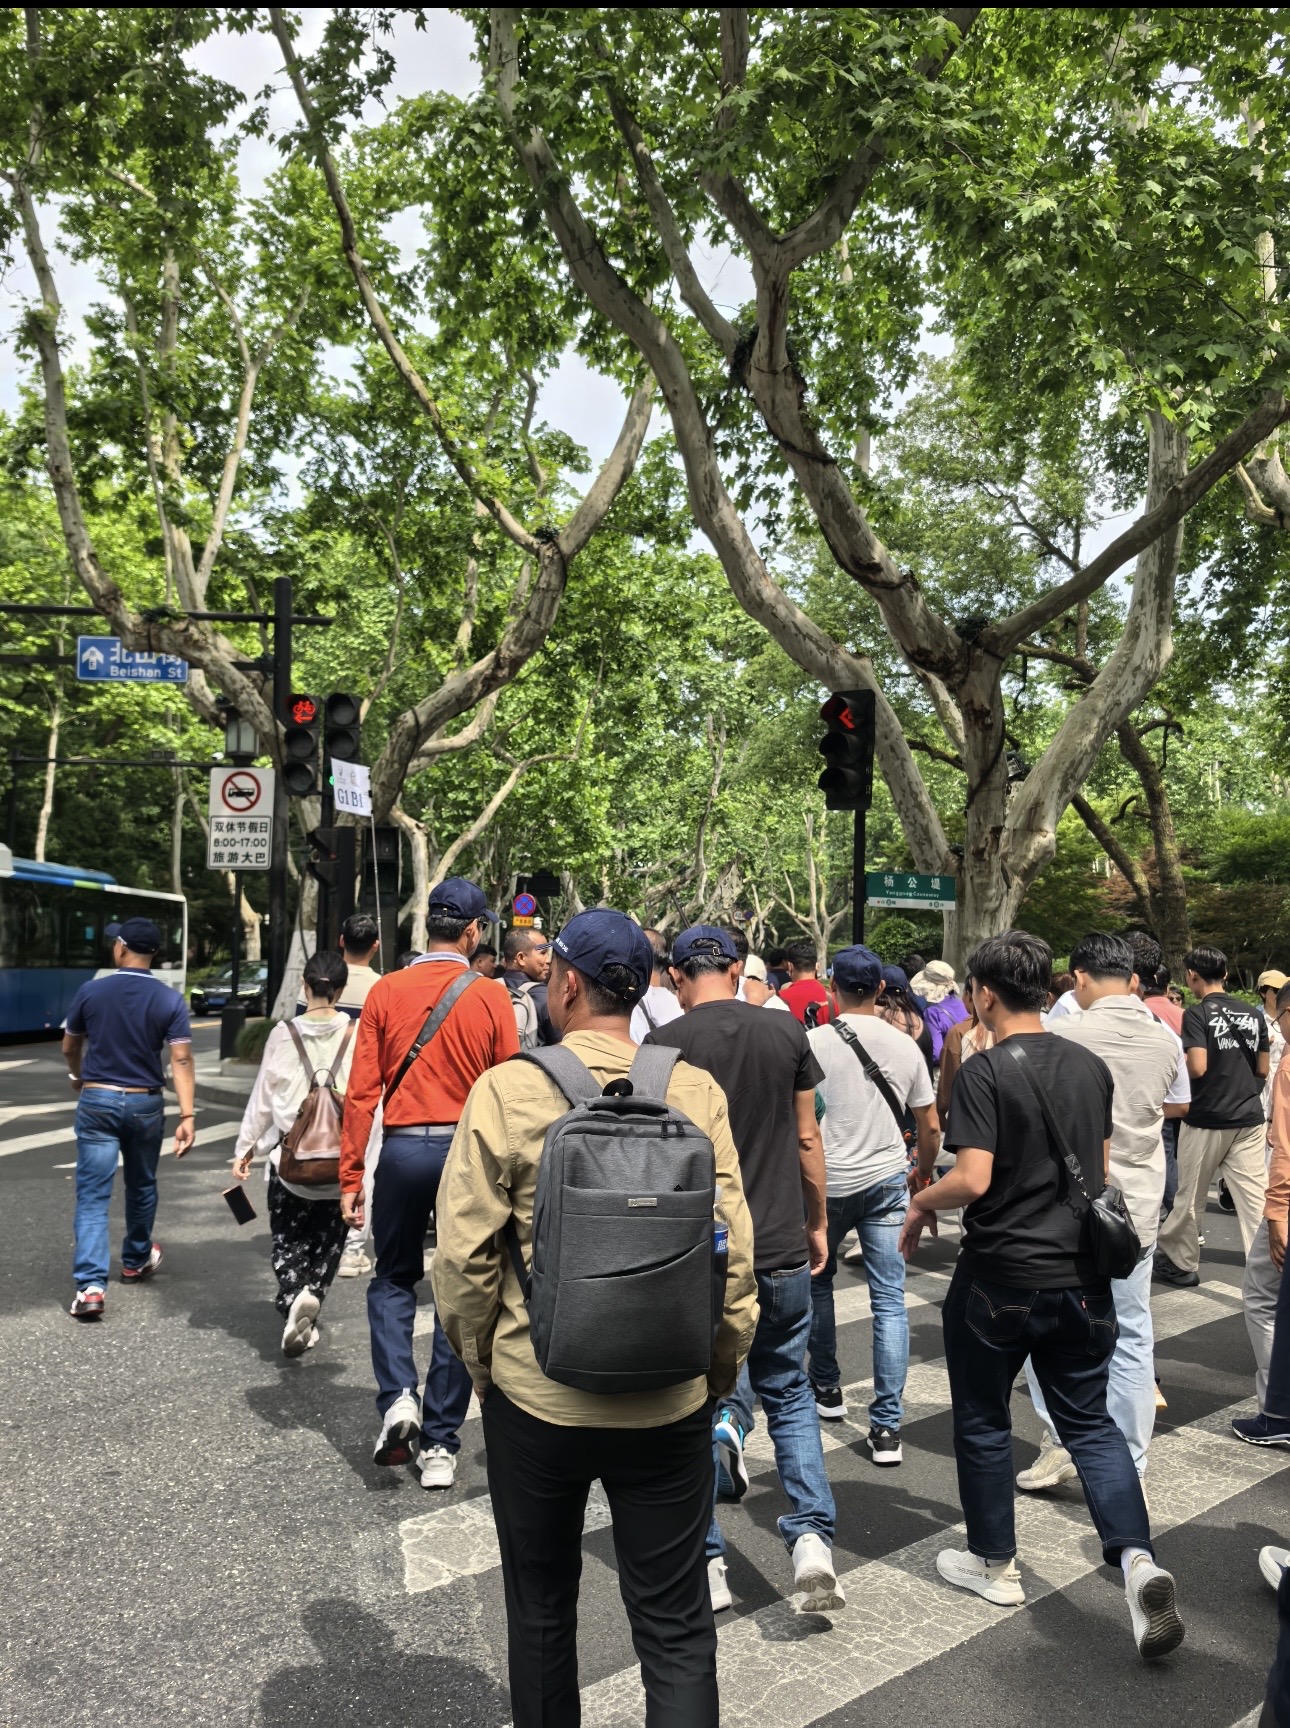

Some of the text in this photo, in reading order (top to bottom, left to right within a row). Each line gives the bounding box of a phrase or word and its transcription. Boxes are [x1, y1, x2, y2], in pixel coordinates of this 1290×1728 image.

[110, 665, 182, 679] Beishan St
[337, 788, 364, 808] G1 B1
[214, 821, 269, 834] 双休节假日
[213, 838, 267, 847] 8:00-17:00
[213, 852, 266, 864] 旅游大巴
[883, 875, 941, 890] 杨公堤
